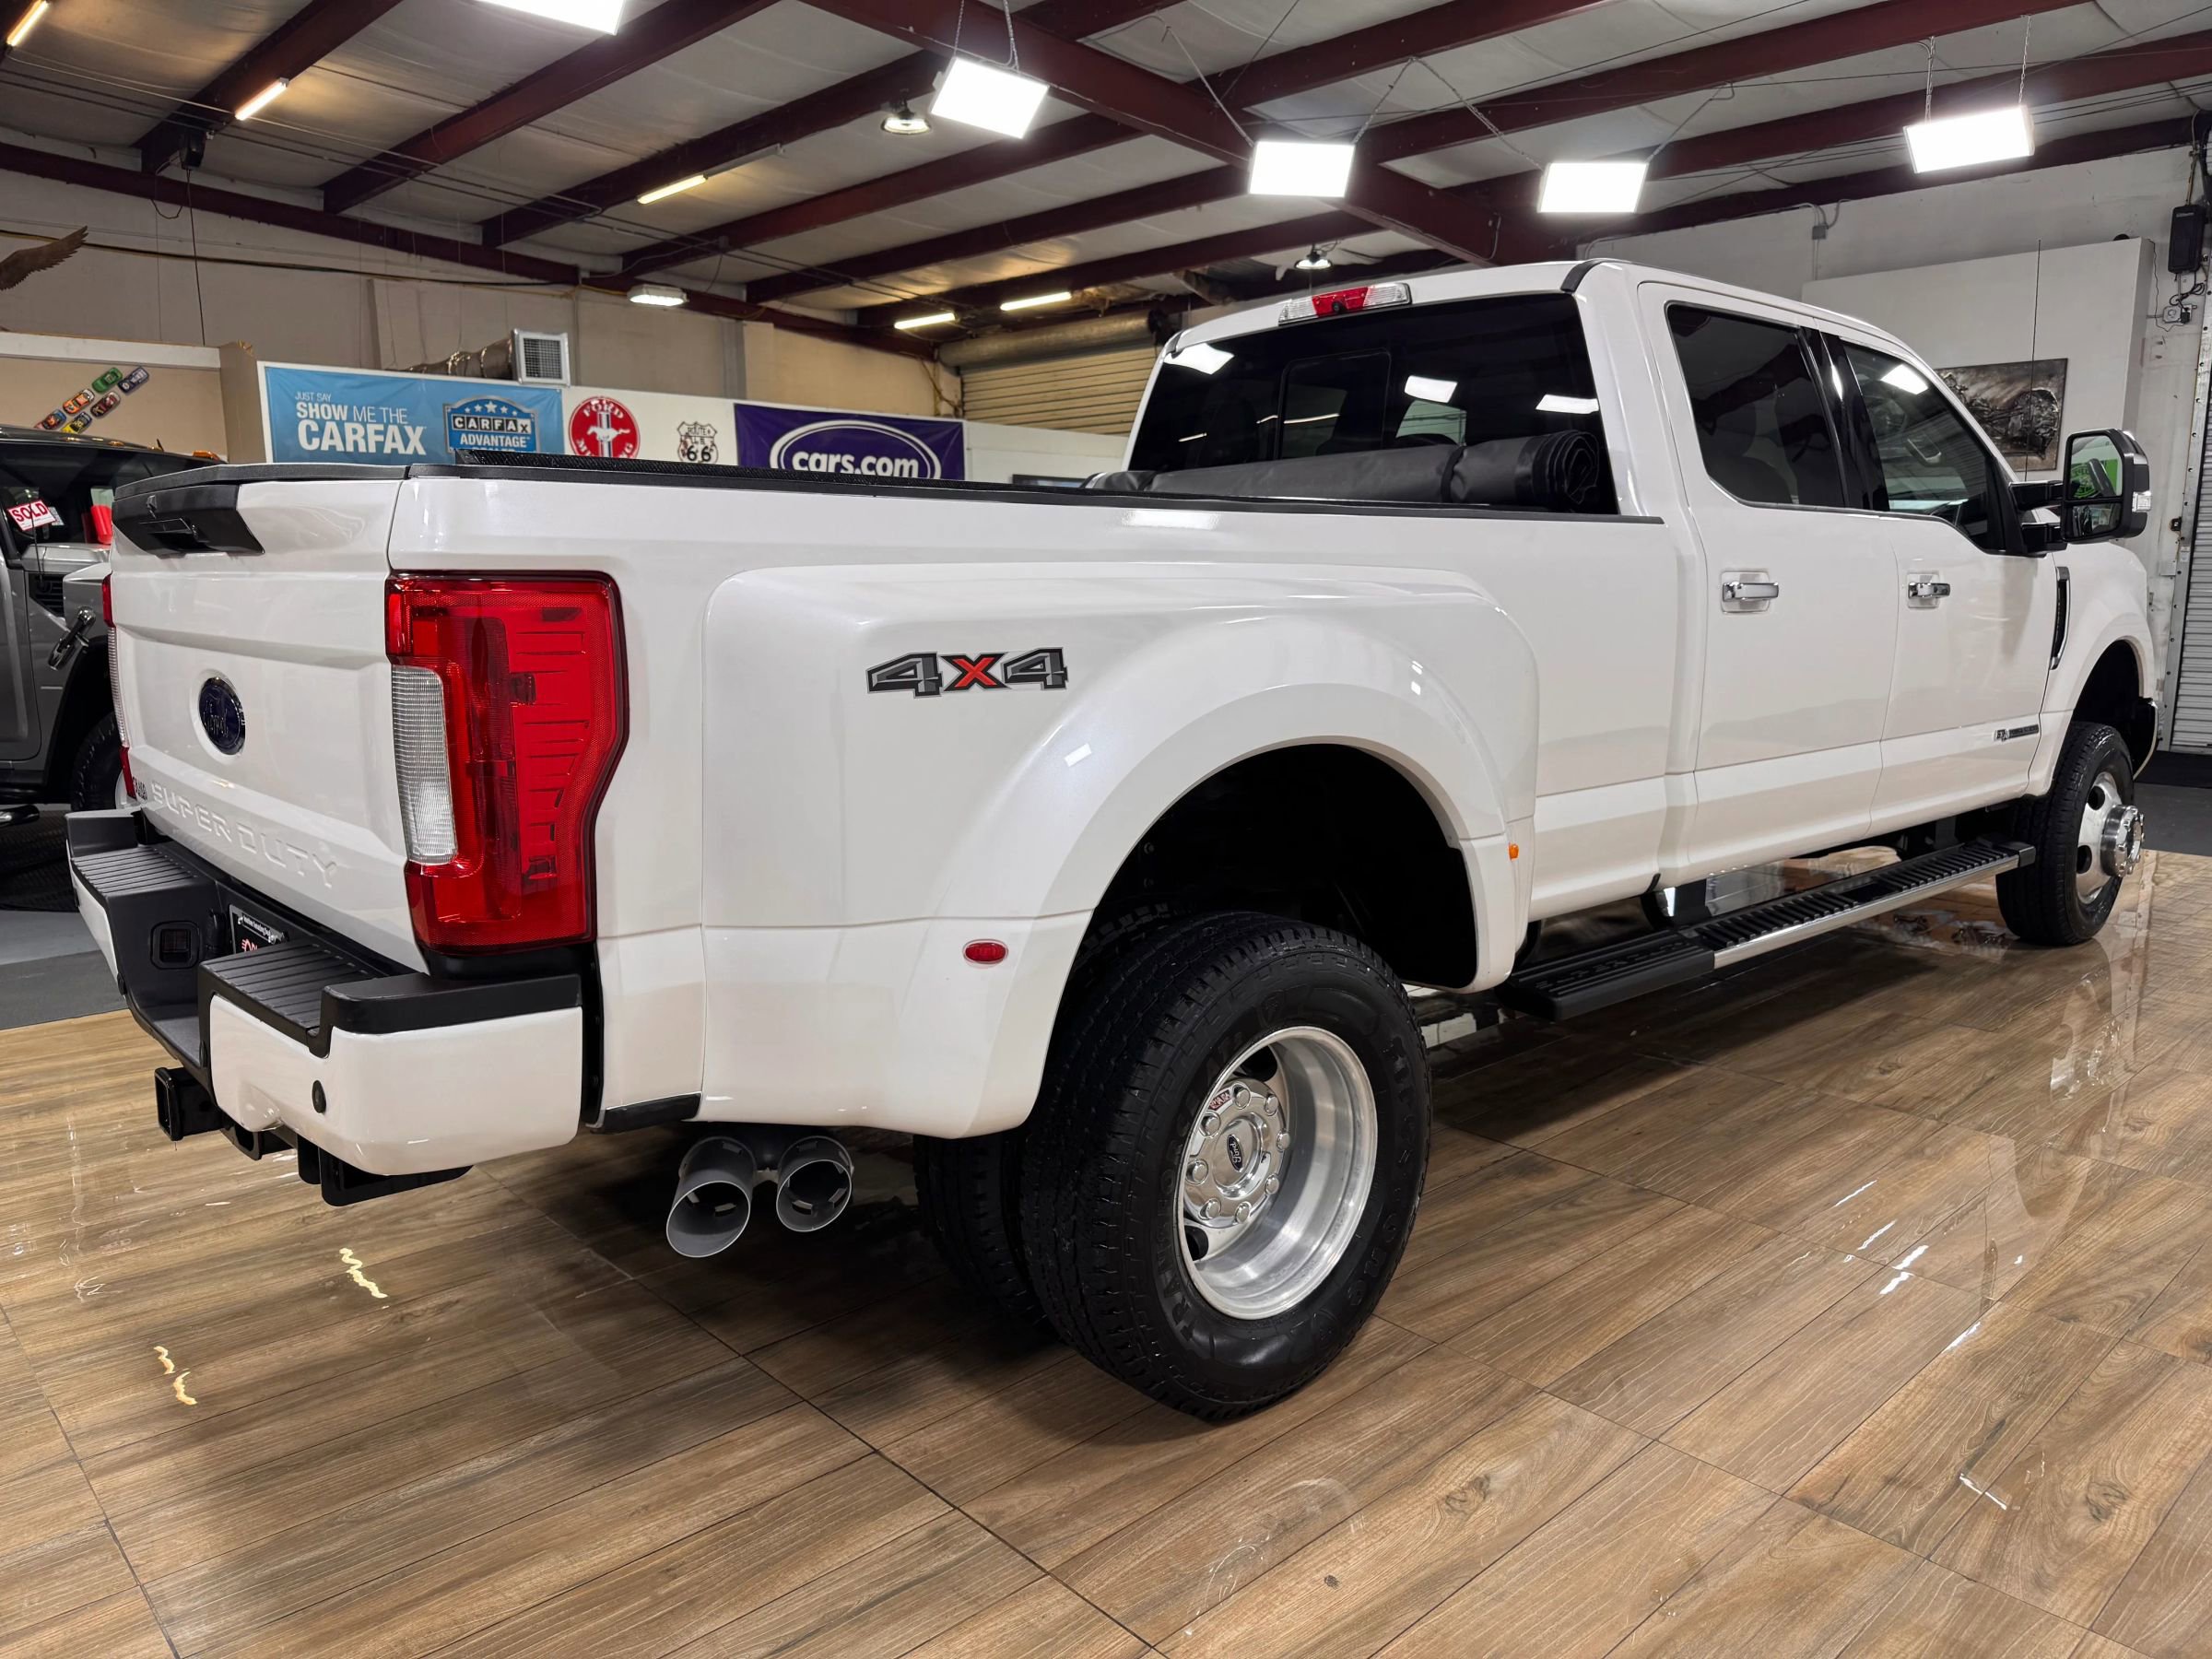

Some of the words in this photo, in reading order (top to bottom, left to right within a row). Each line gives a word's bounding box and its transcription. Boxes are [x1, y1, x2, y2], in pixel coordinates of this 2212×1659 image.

[295, 391, 314, 401] JUST
[316, 393, 331, 403] SAY
[296, 402, 347, 421] SHOW
[353, 406, 376, 423] ME
[379, 407, 408, 424] THE
[454, 417, 528, 433] CARFAX
[298, 419, 427, 455] CARFAX
[460, 433, 528, 448] ADVANTAGE
[687, 445, 712, 462] 66
[792, 451, 919, 477] cars.com
[12, 502, 48, 522] SOLD
[151, 782, 232, 842] SUPER
[236, 822, 337, 888] DUTY
